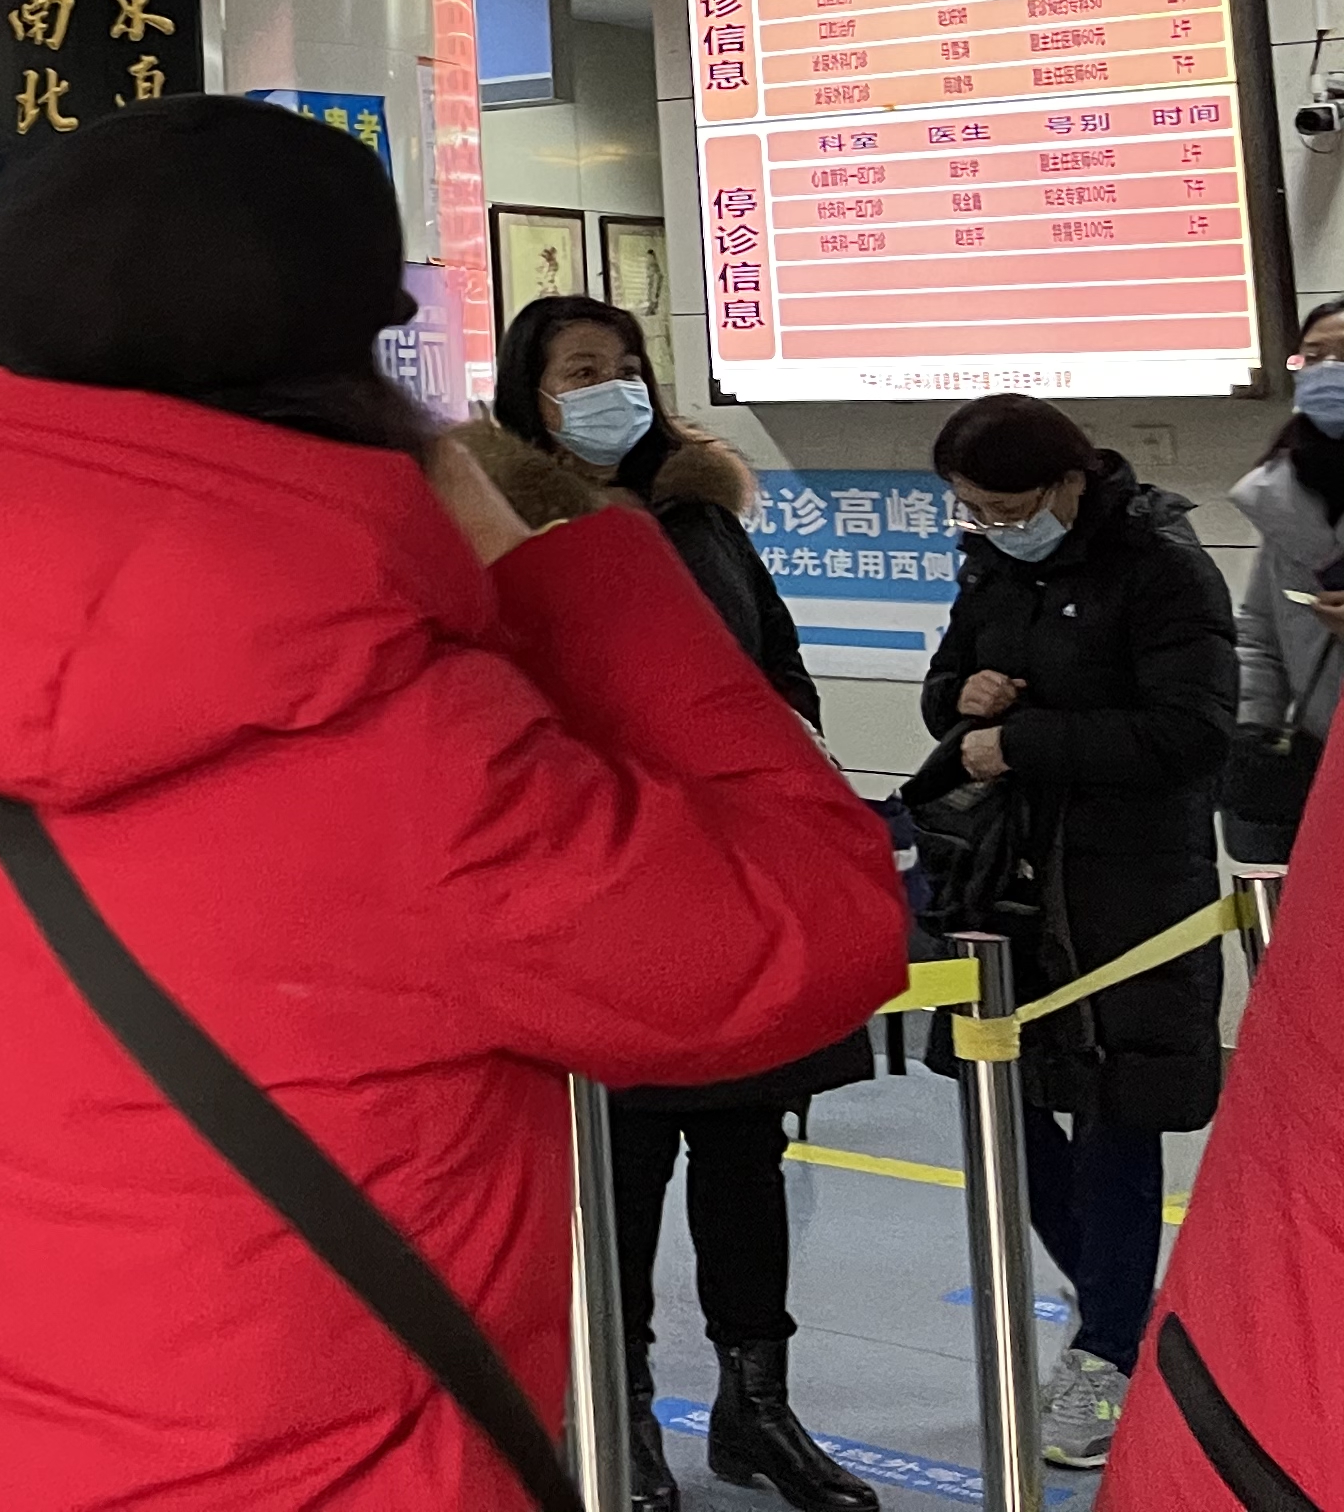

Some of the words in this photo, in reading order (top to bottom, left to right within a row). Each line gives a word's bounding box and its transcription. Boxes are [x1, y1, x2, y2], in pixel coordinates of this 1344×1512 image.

[1170, 19, 1192, 39] 上午
[1172, 55, 1195, 75] 下午
[819, 132, 878, 153] 科室
[928, 123, 991, 144] 医生
[1044, 113, 1111, 135] 号别
[1153, 104, 1220, 127] 时间
[1180, 143, 1202, 163] 上午
[1183, 179, 1206, 199] 下午
[1187, 214, 1209, 235] 上午
[713, 187, 765, 330] 停诊信息
[761, 546, 967, 582] 优先使用西侧
